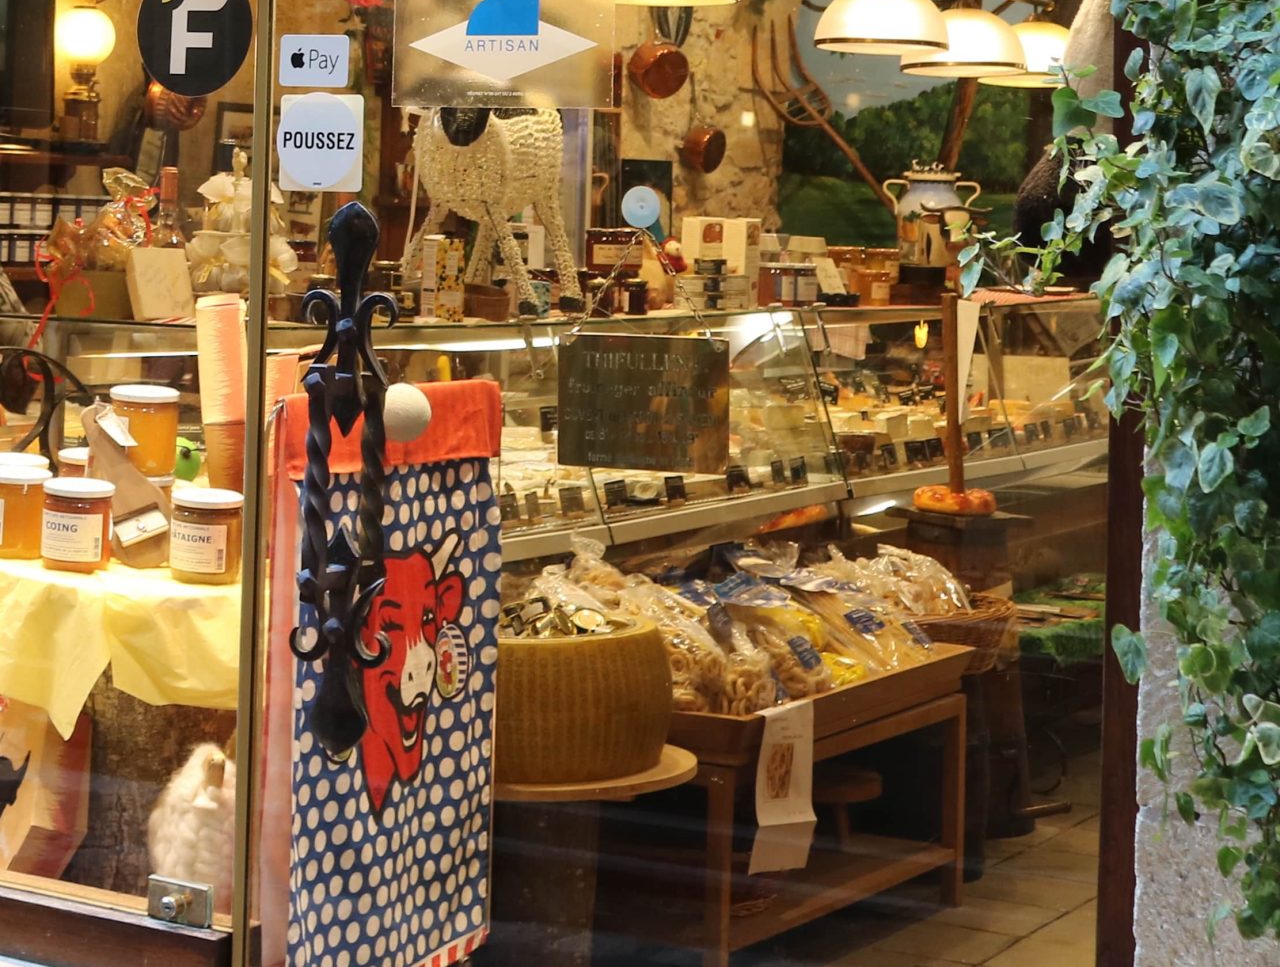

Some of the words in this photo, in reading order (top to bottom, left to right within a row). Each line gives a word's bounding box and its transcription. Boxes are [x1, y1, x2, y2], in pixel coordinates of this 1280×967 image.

[465, 39, 539, 52] ARTISAN
[309, 49, 340, 75] Pay
[283, 130, 355, 150] POUSSEZ
[46, 520, 78, 533] COING
